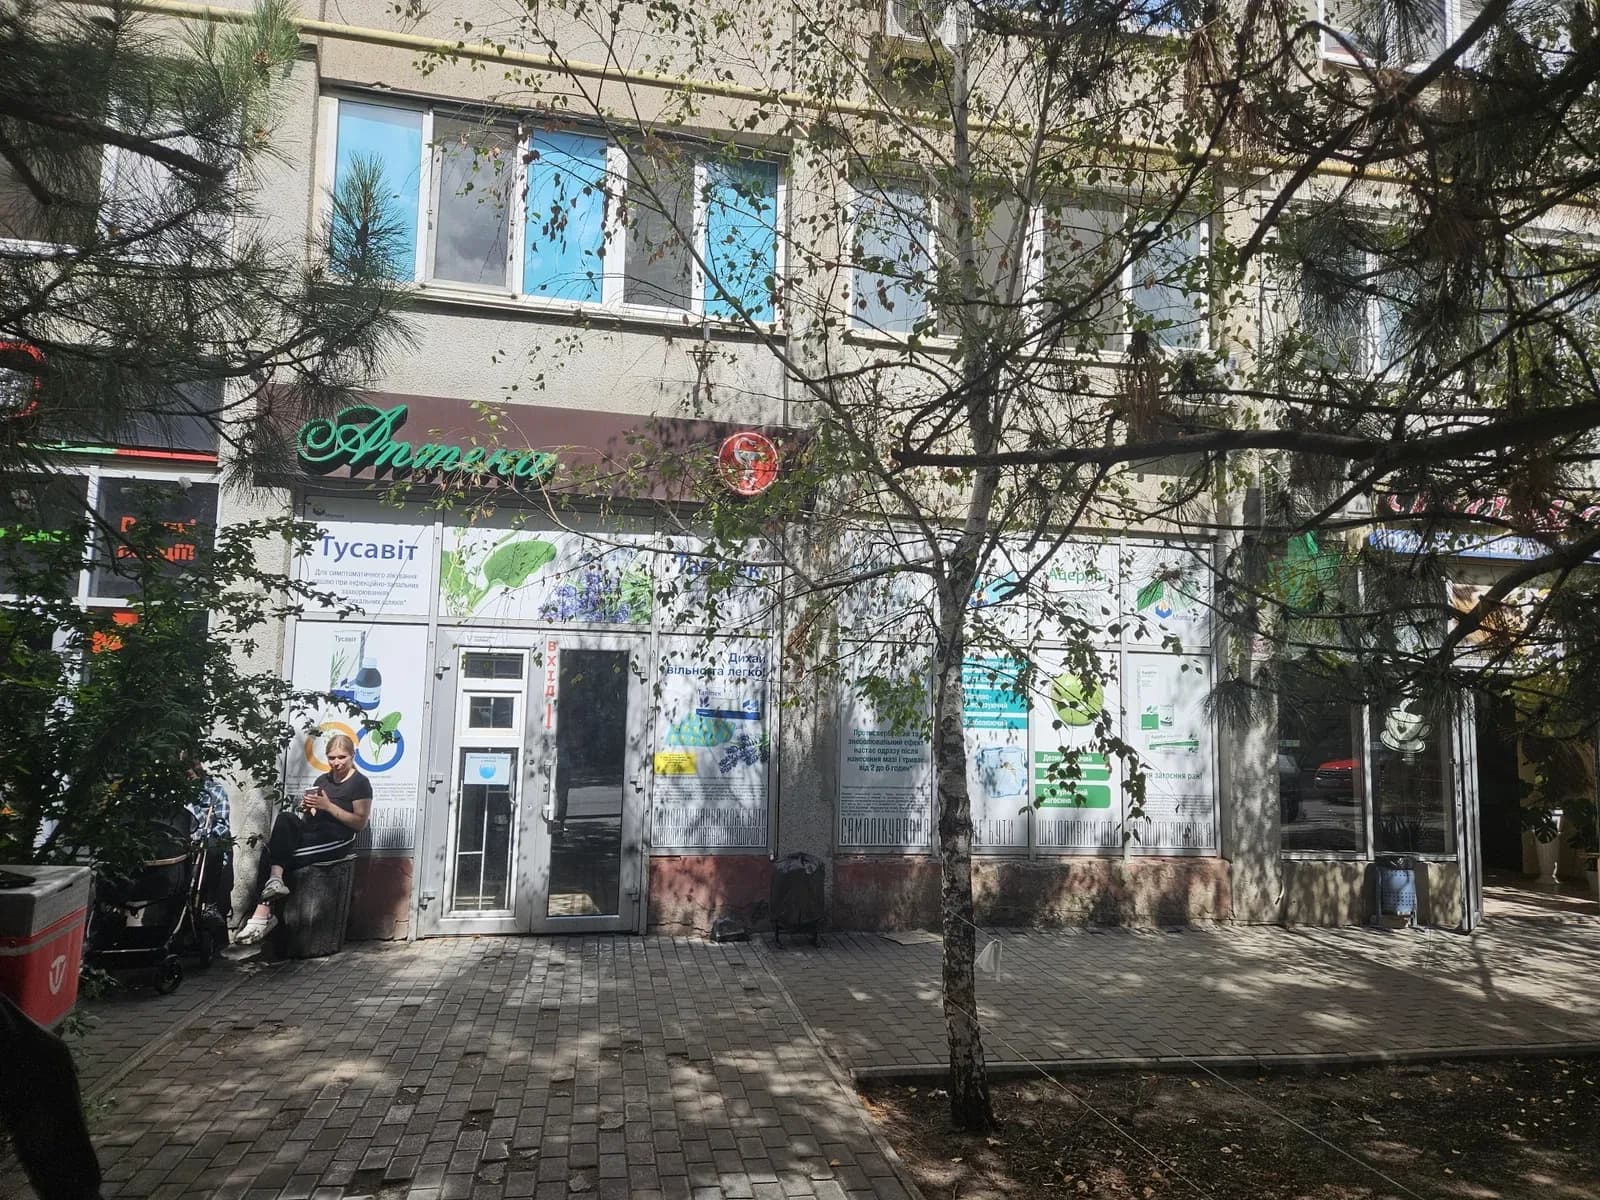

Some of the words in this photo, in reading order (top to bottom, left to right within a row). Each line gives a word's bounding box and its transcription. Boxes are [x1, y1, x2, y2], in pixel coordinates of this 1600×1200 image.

[298, 403, 557, 480] Аптека
[321, 535, 418, 562] Тусавіт
[545, 640, 557, 698] ВХІД
[727, 668, 766, 678] легко!
[840, 817, 930, 846] САМОЛІКУВАННЯ
